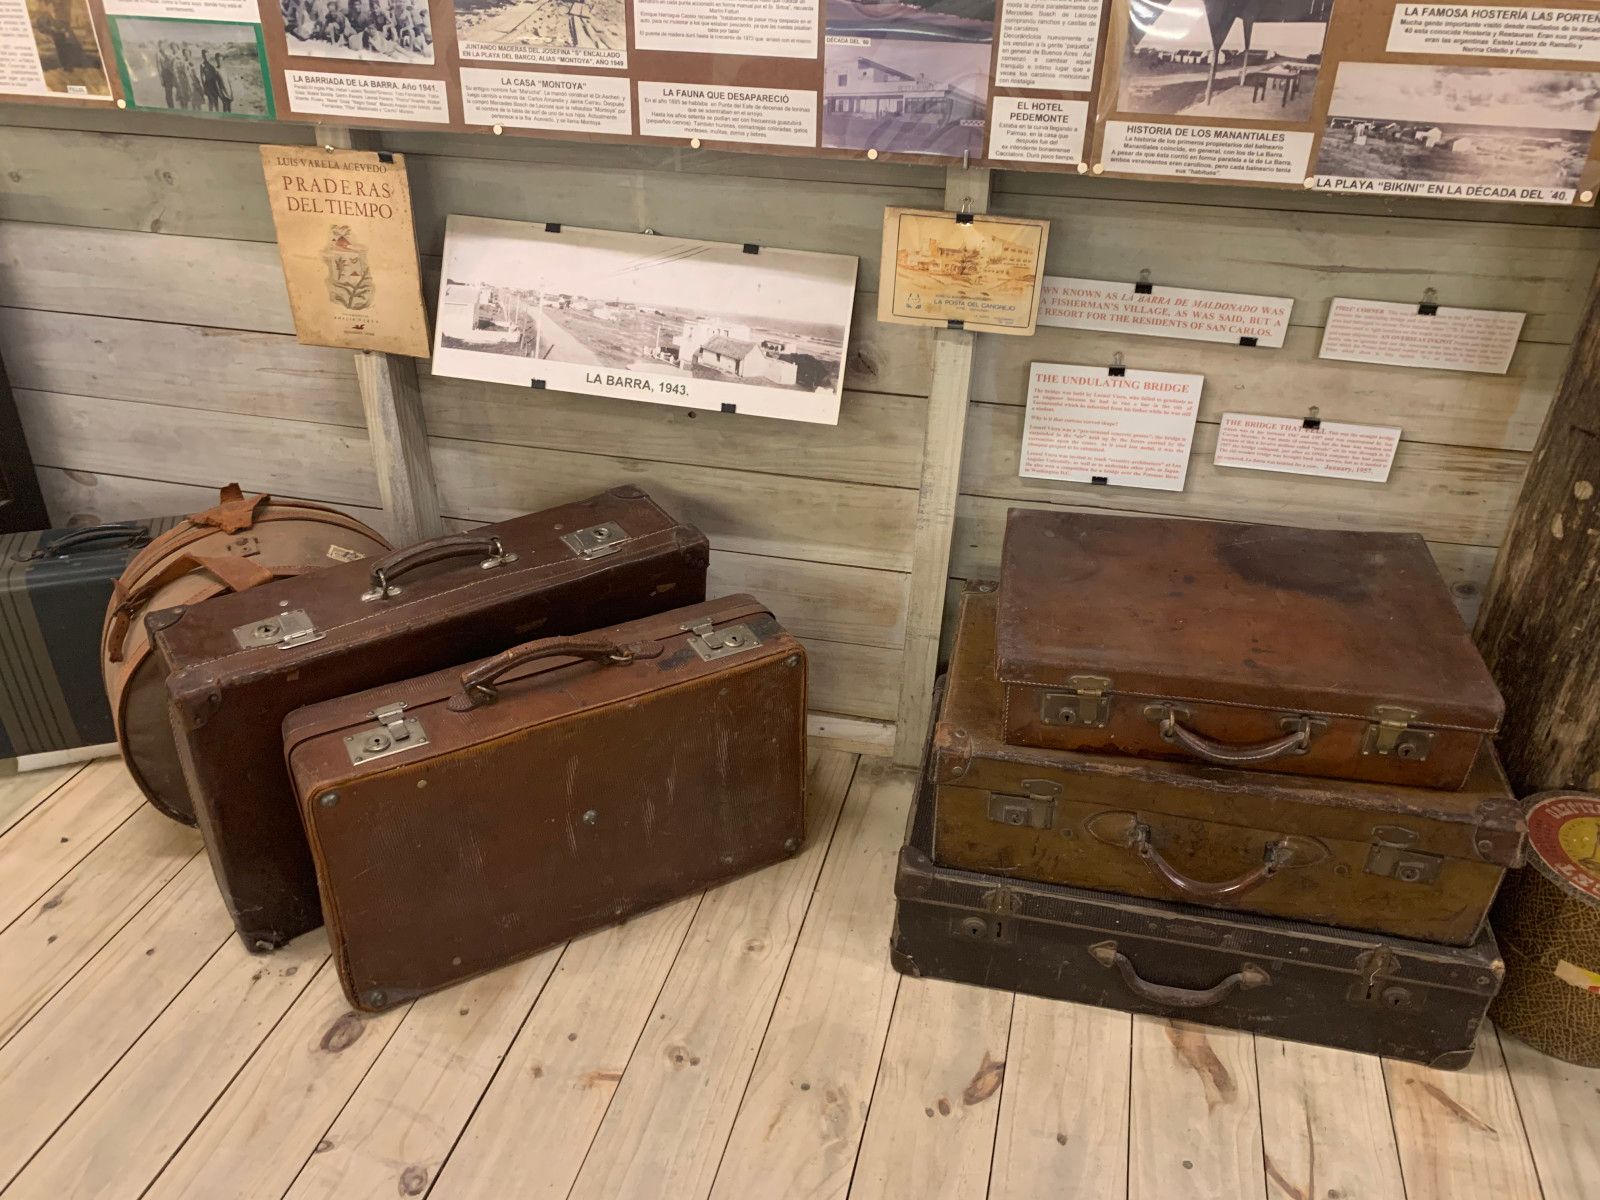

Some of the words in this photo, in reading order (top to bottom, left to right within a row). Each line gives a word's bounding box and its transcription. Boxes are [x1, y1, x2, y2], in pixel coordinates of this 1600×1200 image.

[1405, 8, 1417, 16] LA
[1422, 8, 1468, 18] FAMOSA
[1472, 9, 1527, 20] HOSTERÍA
[1531, 12, 1553, 21] LAS
[584, 50, 620, 58] ENCALLADO
[305, 76, 344, 86] BARRIADA
[371, 81, 399, 89] BARRA.
[419, 84, 438, 92] 1941.
[502, 78, 512, 86] LA
[514, 79, 536, 87] CASA
[538, 80, 586, 90] "MONTOYA"
[663, 89, 673, 97] LA
[676, 90, 704, 98] FAUNA
[728, 93, 789, 103] DESAPARECIÓ
[1018, 102, 1029, 110] EL
[1032, 102, 1063, 111] HOTEL
[1010, 113, 1069, 123] PEDEMONTE
[1127, 126, 1172, 136] HISTORIA
[1175, 128, 1188, 137] DE
[1191, 129, 1211, 138] LOS
[1214, 130, 1285, 142] MANANTIALES
[277, 157, 298, 167] LUIS
[299, 159, 340, 170] VARELA
[343, 162, 387, 173] ACEVEDO
[282, 176, 391, 198] PRADERAS
[1317, 178, 1331, 188] LA
[1335, 179, 1373, 190] PLAYA
[1427, 184, 1443, 194] EN
[1447, 185, 1462, 195] LA
[1466, 185, 1517, 198] DÉCADA
[1520, 188, 1543, 199] DEL
[287, 197, 323, 214] DEL
[325, 199, 393, 219] TIEMPO
[982, 303, 1015, 311] CANGREJO
[1062, 289, 1102, 299] KNOWN
[1105, 292, 1117, 300] AS
[1121, 294, 1134, 302] LA
[1137, 295, 1171, 305] BARRA
[1174, 298, 1189, 307] DE
[1193, 299, 1257, 313] MALDONADO
[1262, 305, 1285, 316] WAS
[1052, 299, 1119, 311] FISHERMAN'S
[1123, 305, 1171, 317] VILLAGE,
[1175, 310, 1188, 318] AS
[1192, 311, 1214, 321] WAS
[1219, 314, 1245, 324] SAID,
[1249, 316, 1271, 326] BUT
[1274, 318, 1281, 327] A
[1045, 308, 1083, 319] RESORT
[1086, 312, 1106, 321] FOR
[1110, 314, 1130, 323] THE
[1132, 316, 1190, 329] RESIDENTS
[1190, 321, 1204, 330] OF
[1206, 323, 1227, 333] SAN
[1228, 325, 1272, 337] CARLOS.
[586, 373, 602, 385] LA
[607, 376, 654, 392] BARRA,
[659, 382, 689, 396] 1943.
[1036, 374, 1058, 384] THE
[1062, 376, 1140, 390] UNDULATING
[1144, 381, 1189, 393] BRIDGE
[1225, 419, 1242, 427] THE
[1245, 421, 1277, 430] BRIDGE
[1280, 424, 1302, 432] THAT
